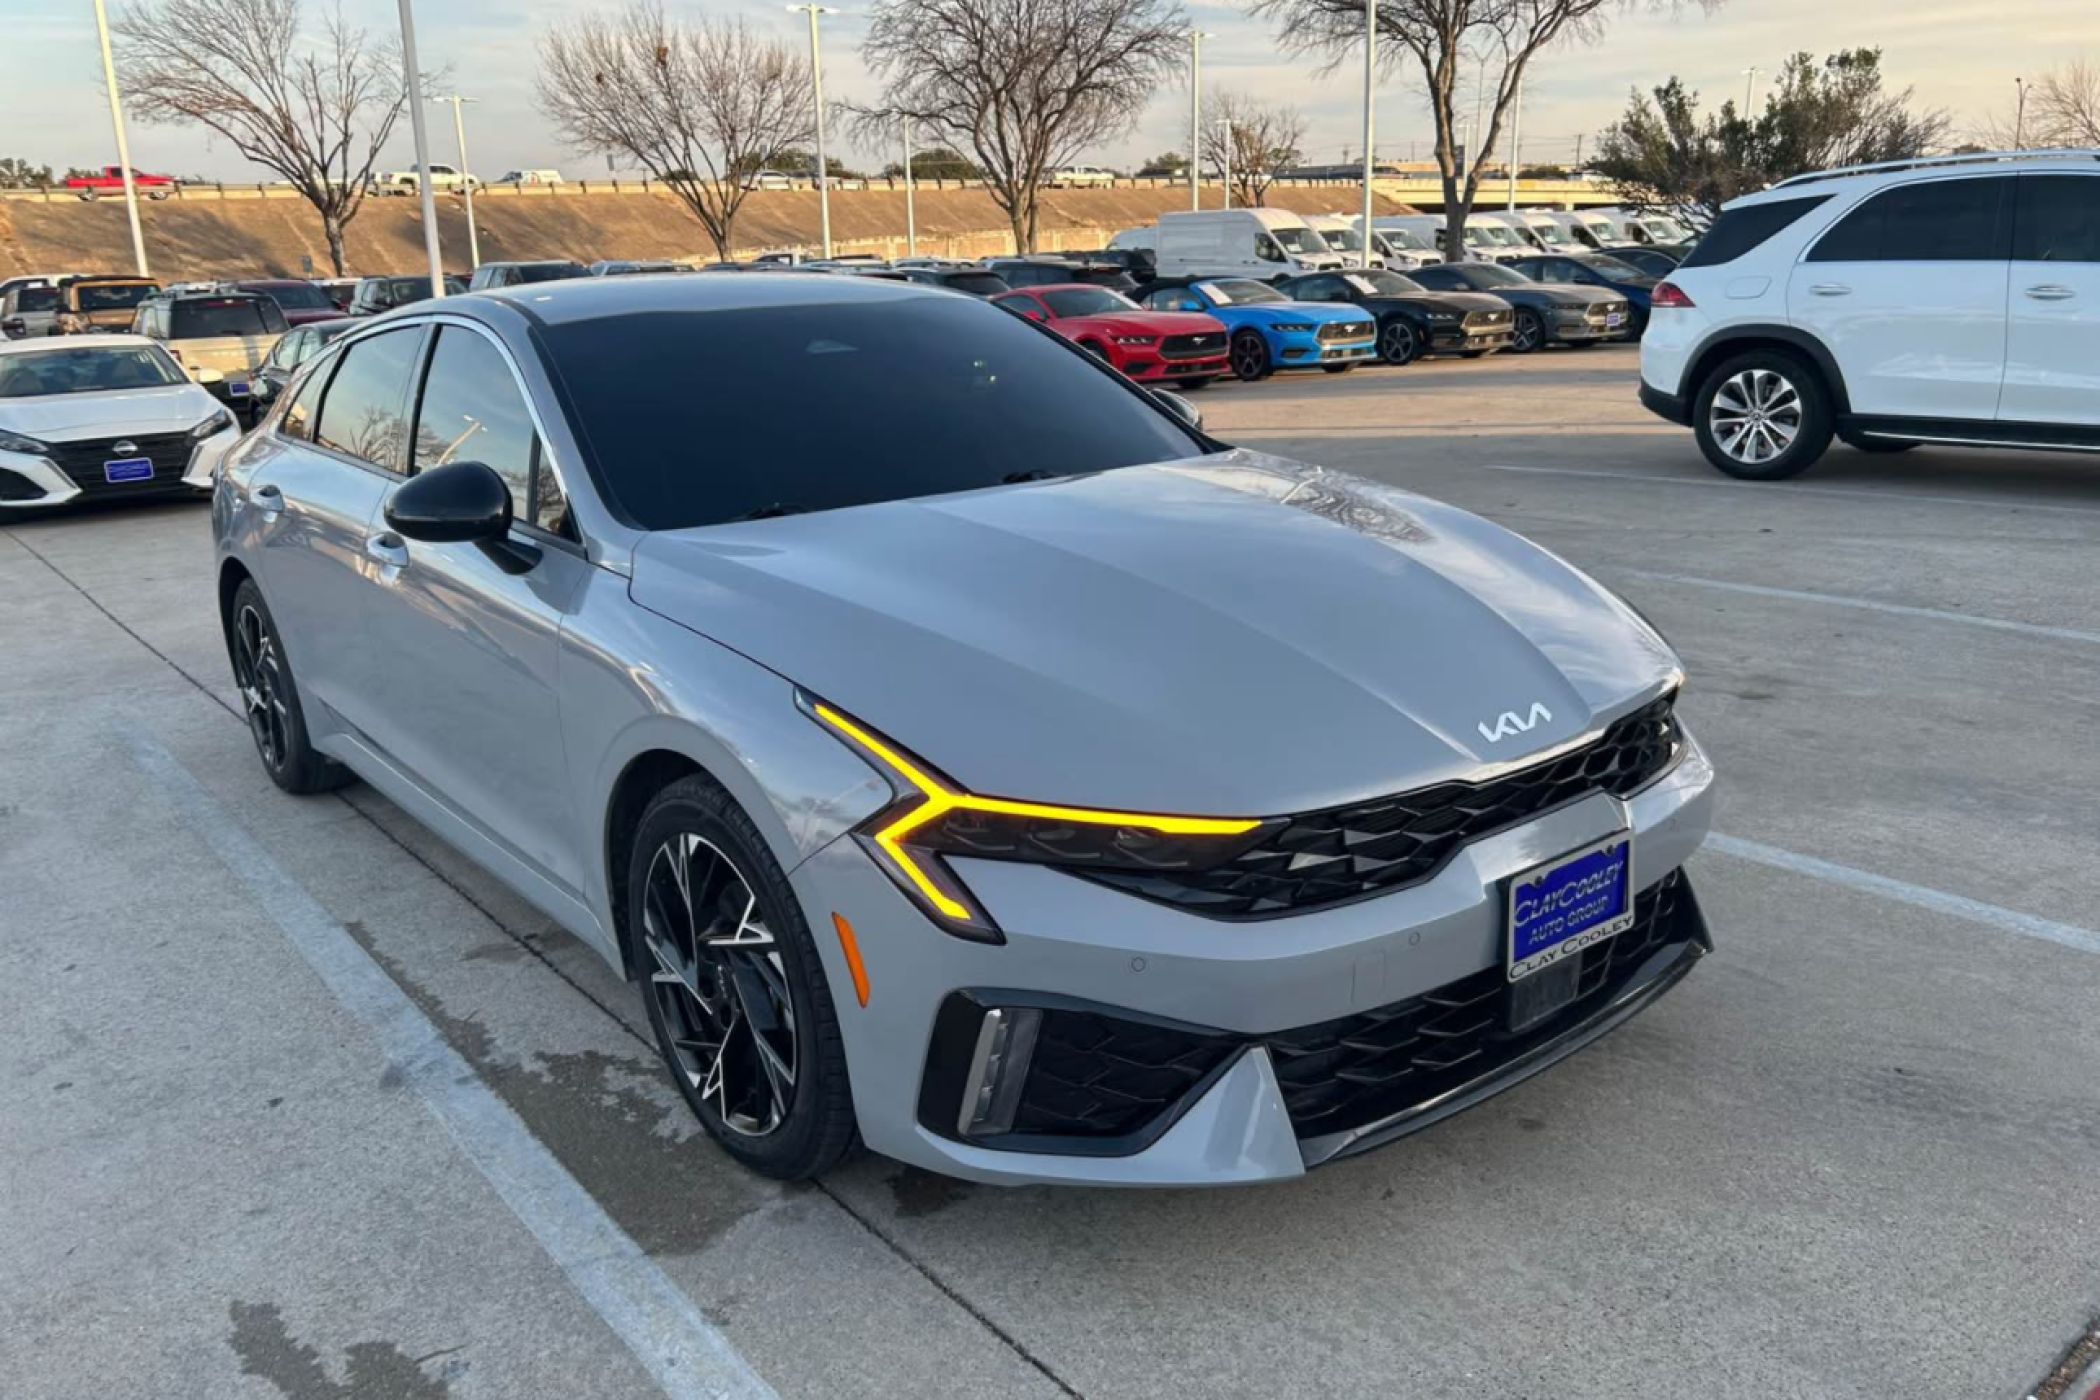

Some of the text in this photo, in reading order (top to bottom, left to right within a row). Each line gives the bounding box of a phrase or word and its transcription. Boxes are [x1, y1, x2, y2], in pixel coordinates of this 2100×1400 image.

[1509, 915, 1632, 978] CLAY COOLEY
[1528, 896, 1608, 945] AUTO GROUP
